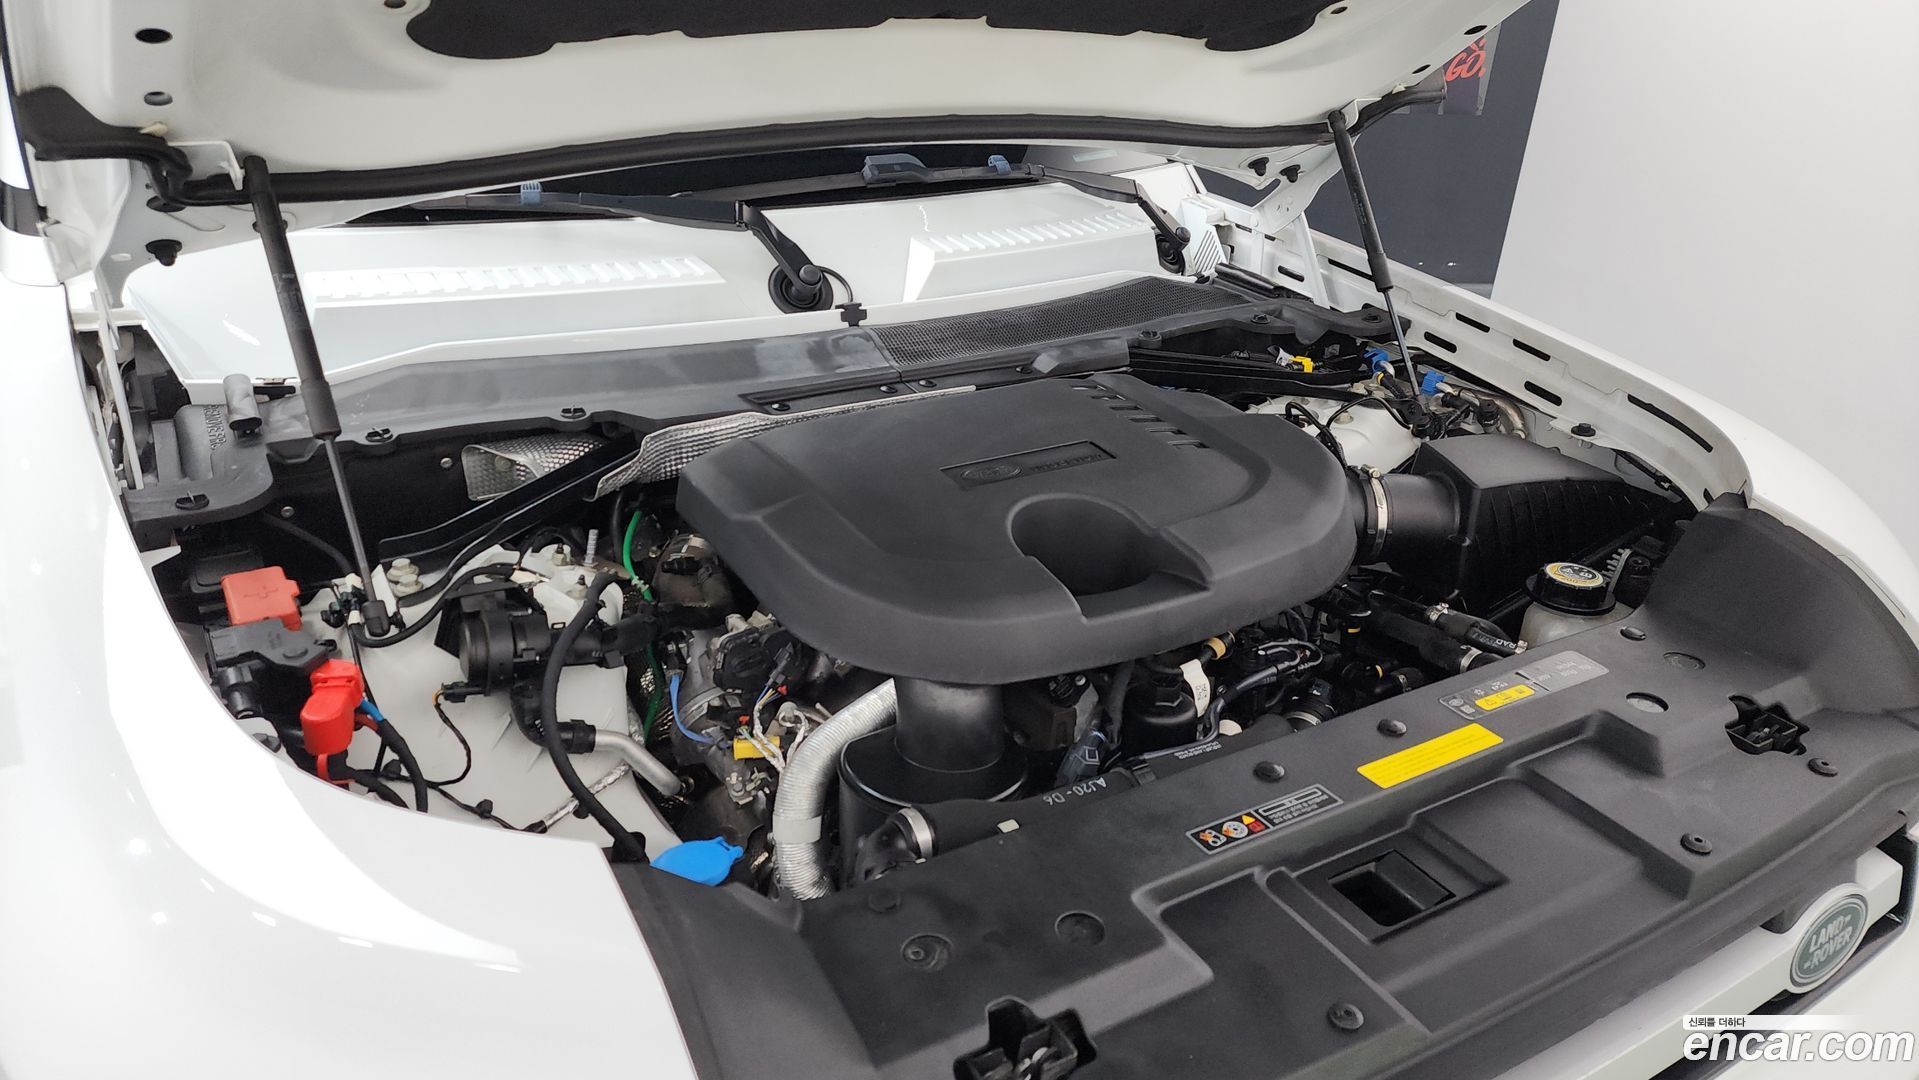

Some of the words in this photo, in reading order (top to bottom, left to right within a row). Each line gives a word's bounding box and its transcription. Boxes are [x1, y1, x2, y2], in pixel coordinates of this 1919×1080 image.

[1496, 639, 1517, 649] RAD
[1809, 915, 1845, 954] LAND
[1811, 926, 1853, 969] ROVER
